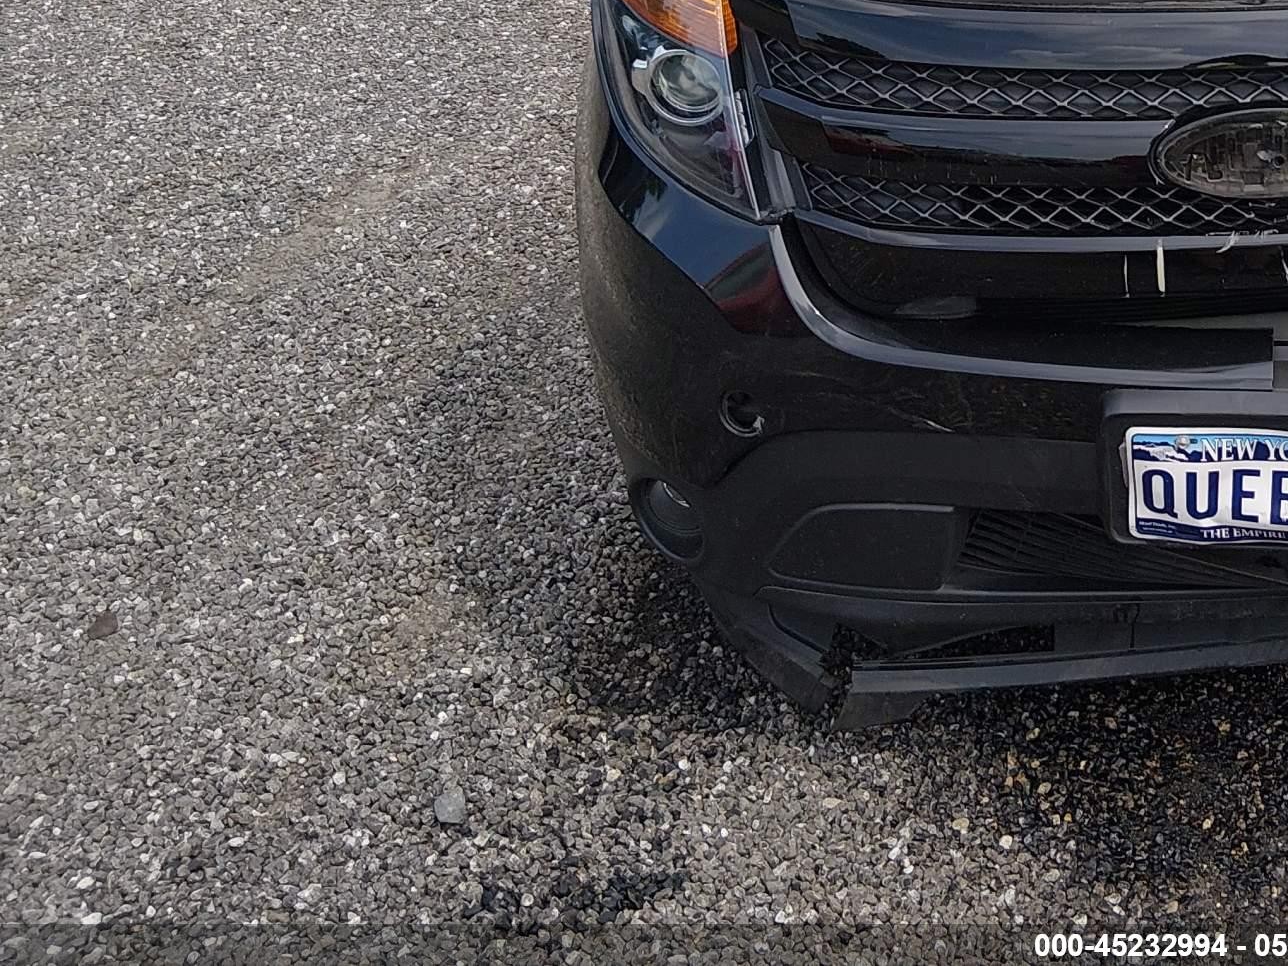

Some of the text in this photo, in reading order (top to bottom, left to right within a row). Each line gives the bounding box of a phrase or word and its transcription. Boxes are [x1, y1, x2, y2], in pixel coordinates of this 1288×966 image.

[1200, 438, 1260, 462] NEW
[1200, 528, 1230, 539] THE
[1232, 528, 1286, 540] EMPIRE
